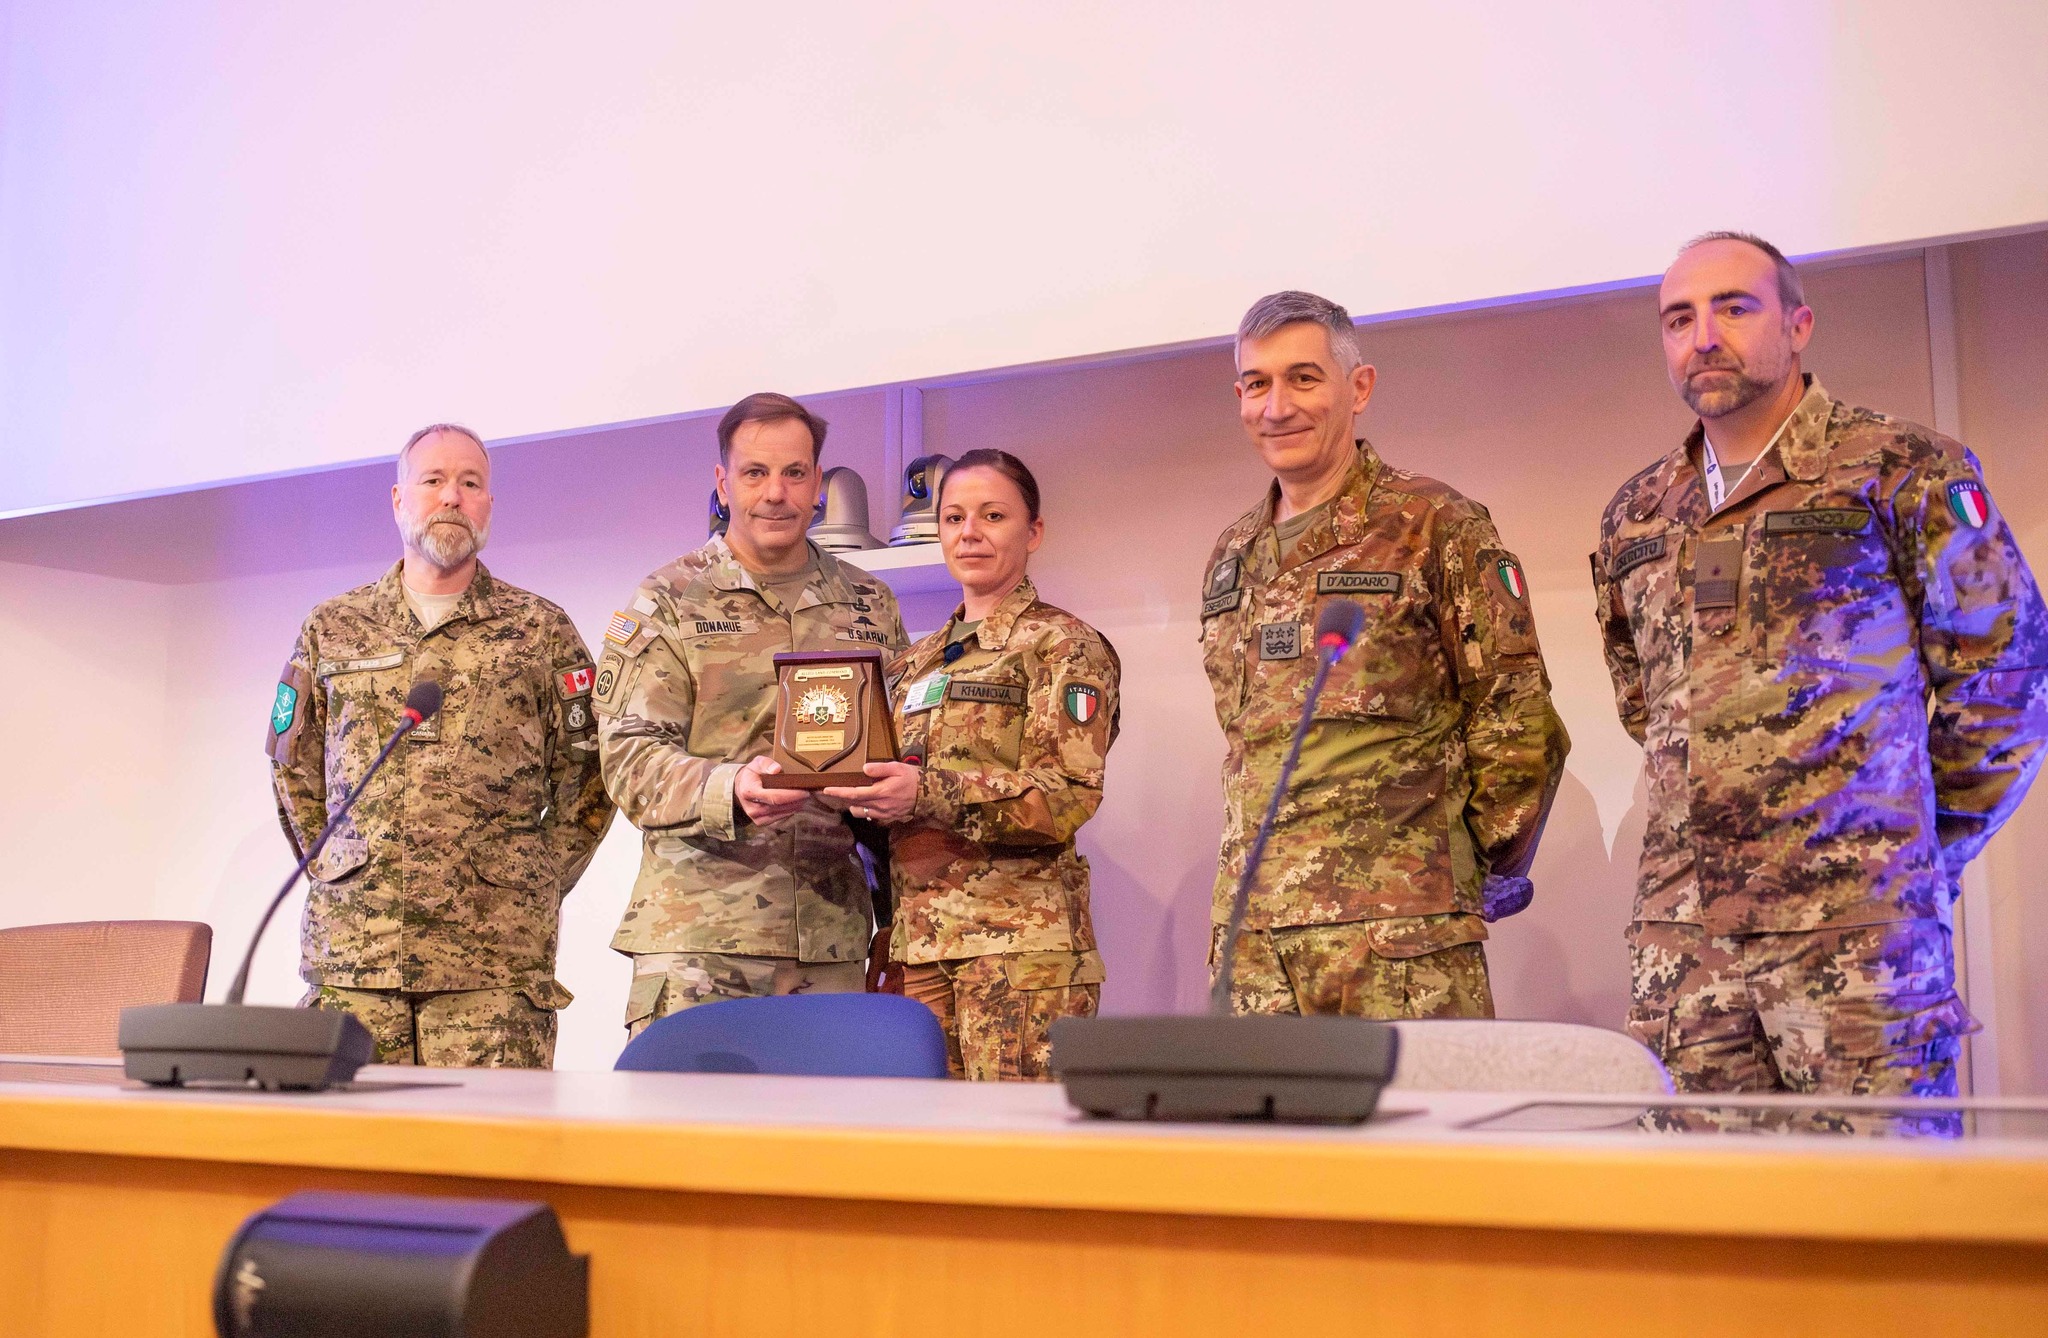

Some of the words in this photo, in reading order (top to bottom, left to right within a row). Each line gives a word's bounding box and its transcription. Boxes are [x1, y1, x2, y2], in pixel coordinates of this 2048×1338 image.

[1326, 576, 1389, 587] D'ADDARIO
[695, 621, 742, 634] DONAHUE
[865, 630, 888, 645] ARMY
[960, 685, 1011, 700] KHANOVA
[1069, 686, 1096, 697] ITALIA
